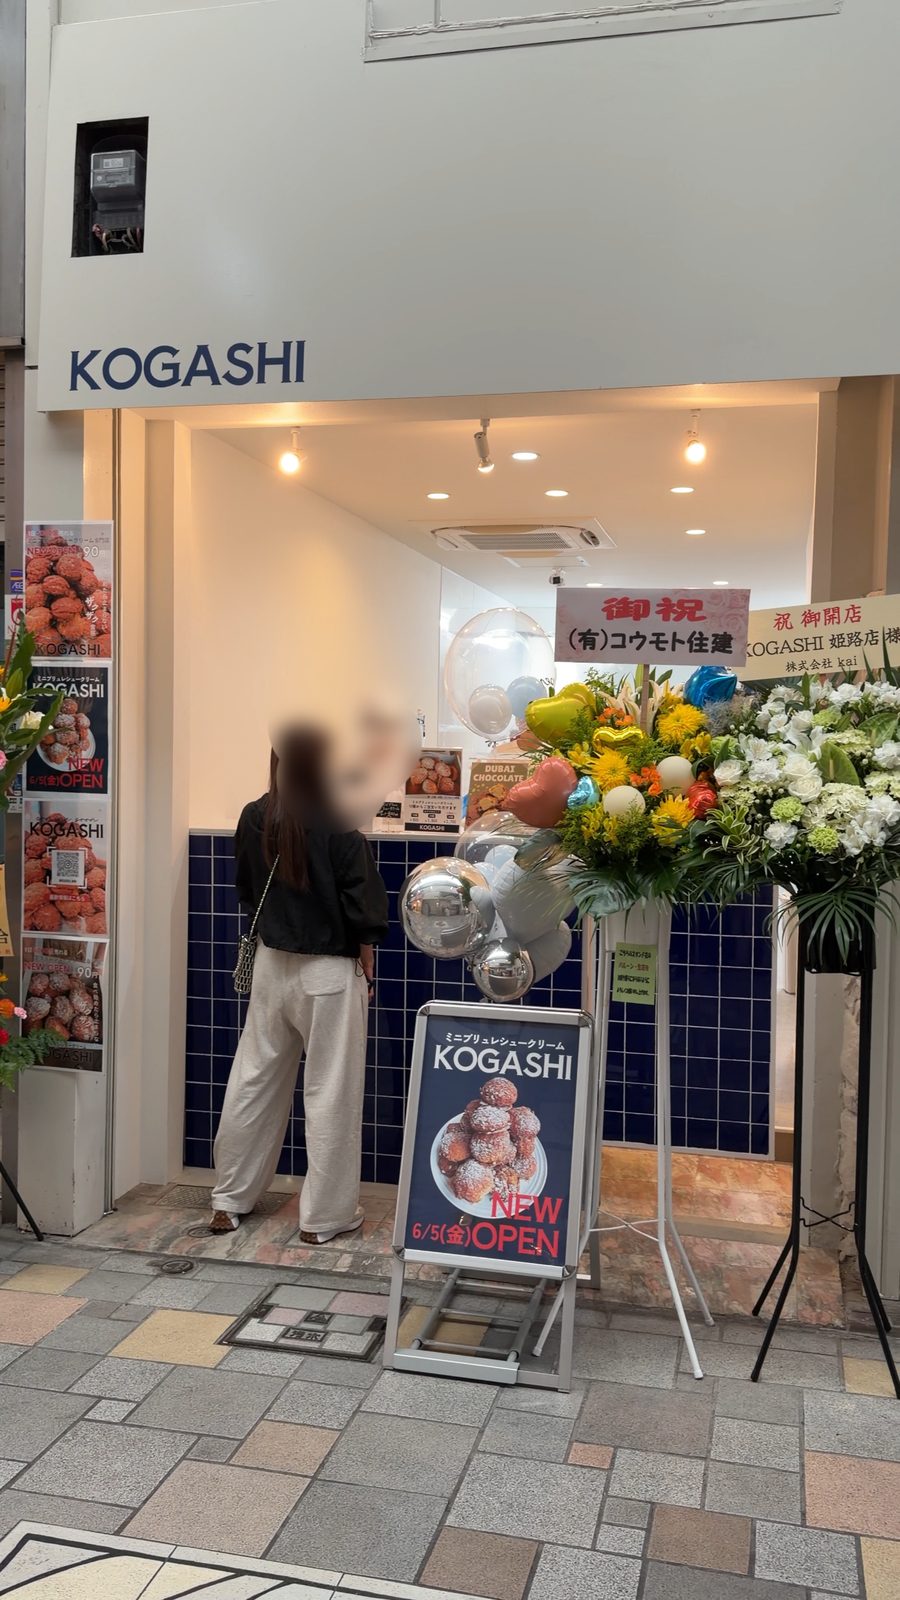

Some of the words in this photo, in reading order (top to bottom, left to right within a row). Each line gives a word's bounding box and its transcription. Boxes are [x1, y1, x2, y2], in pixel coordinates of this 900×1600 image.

[69, 340, 306, 391] KOGASHI
[601, 597, 707, 622] 御祝
[773, 612, 793, 630] 祝
[800, 604, 861, 628] 御開店
[569, 627, 734, 655] (有)コウモト住建
[829, 629, 879, 649] 姫路店
[37, 643, 101, 656] KOGASHI
[785, 658, 833, 672] 株式会社
[837, 656, 858, 667] kai
[68, 757, 104, 772] NEW
[485, 765, 516, 773] DUBAI
[60, 773, 104, 788] OPEN
[473, 774, 525, 782] CHOCOLATE
[29, 821, 104, 838] KOGASHI
[445, 1032, 566, 1050] ミニブリュレシュークリーム
[433, 1044, 573, 1080] KOGASHI
[491, 1193, 564, 1225] NEW
[412, 1222, 471, 1247] 6/5(金)
[472, 1221, 560, 1258] OPEN
